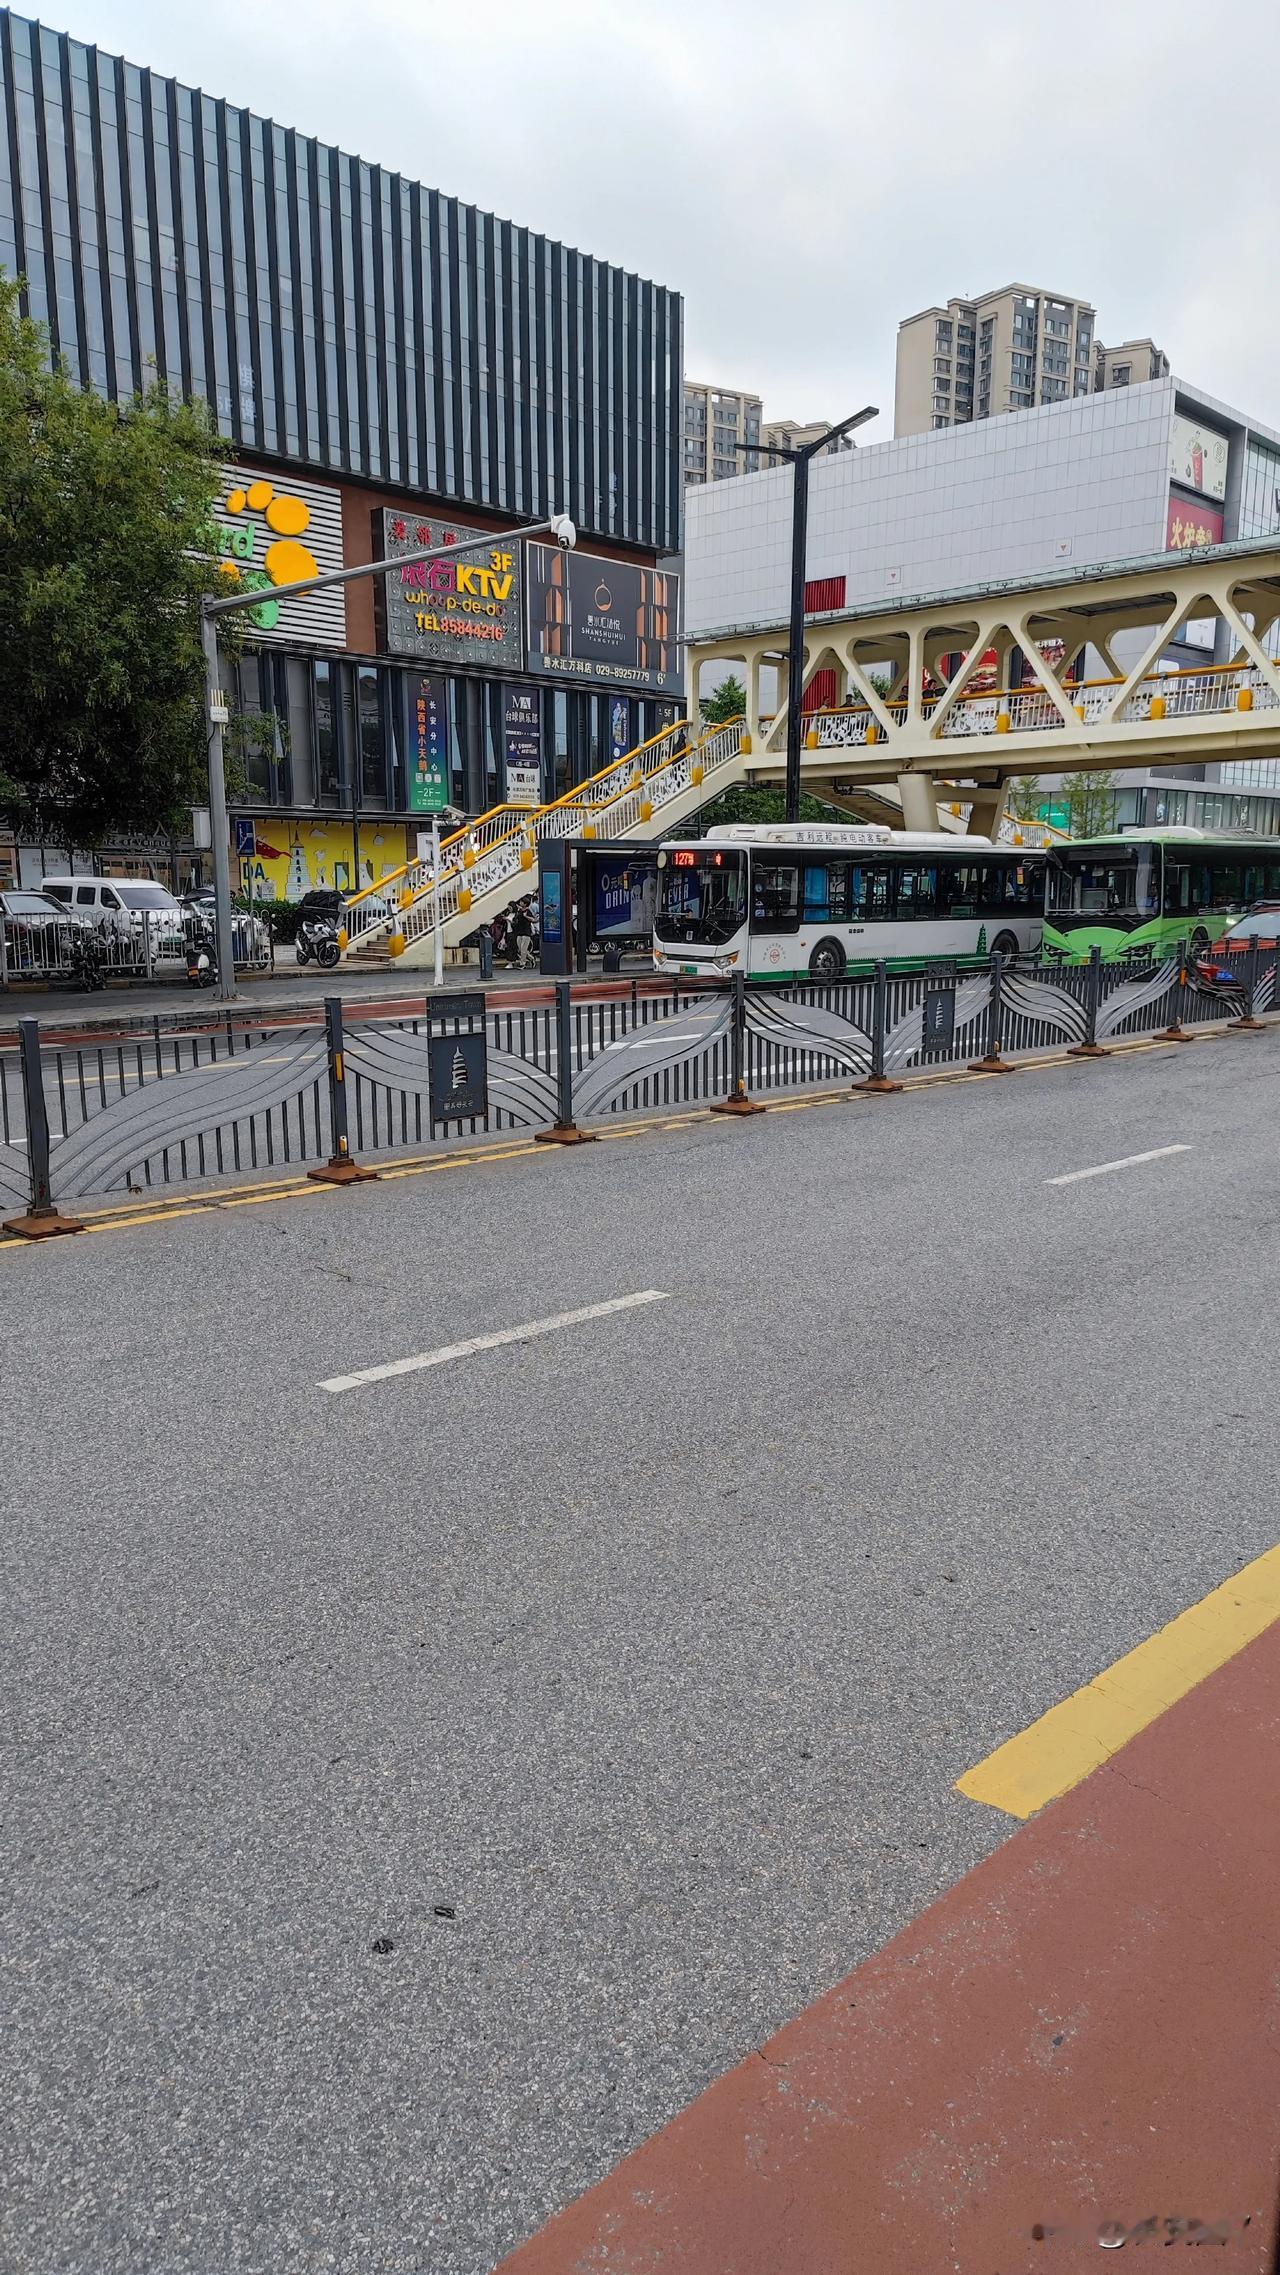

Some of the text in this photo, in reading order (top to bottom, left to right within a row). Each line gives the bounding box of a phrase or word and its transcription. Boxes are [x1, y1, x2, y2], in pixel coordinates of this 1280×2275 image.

[490, 551, 513, 573] 3F
[581, 626, 626, 641] SHANSHUIHUI
[595, 664, 650, 682] 029-89257779
